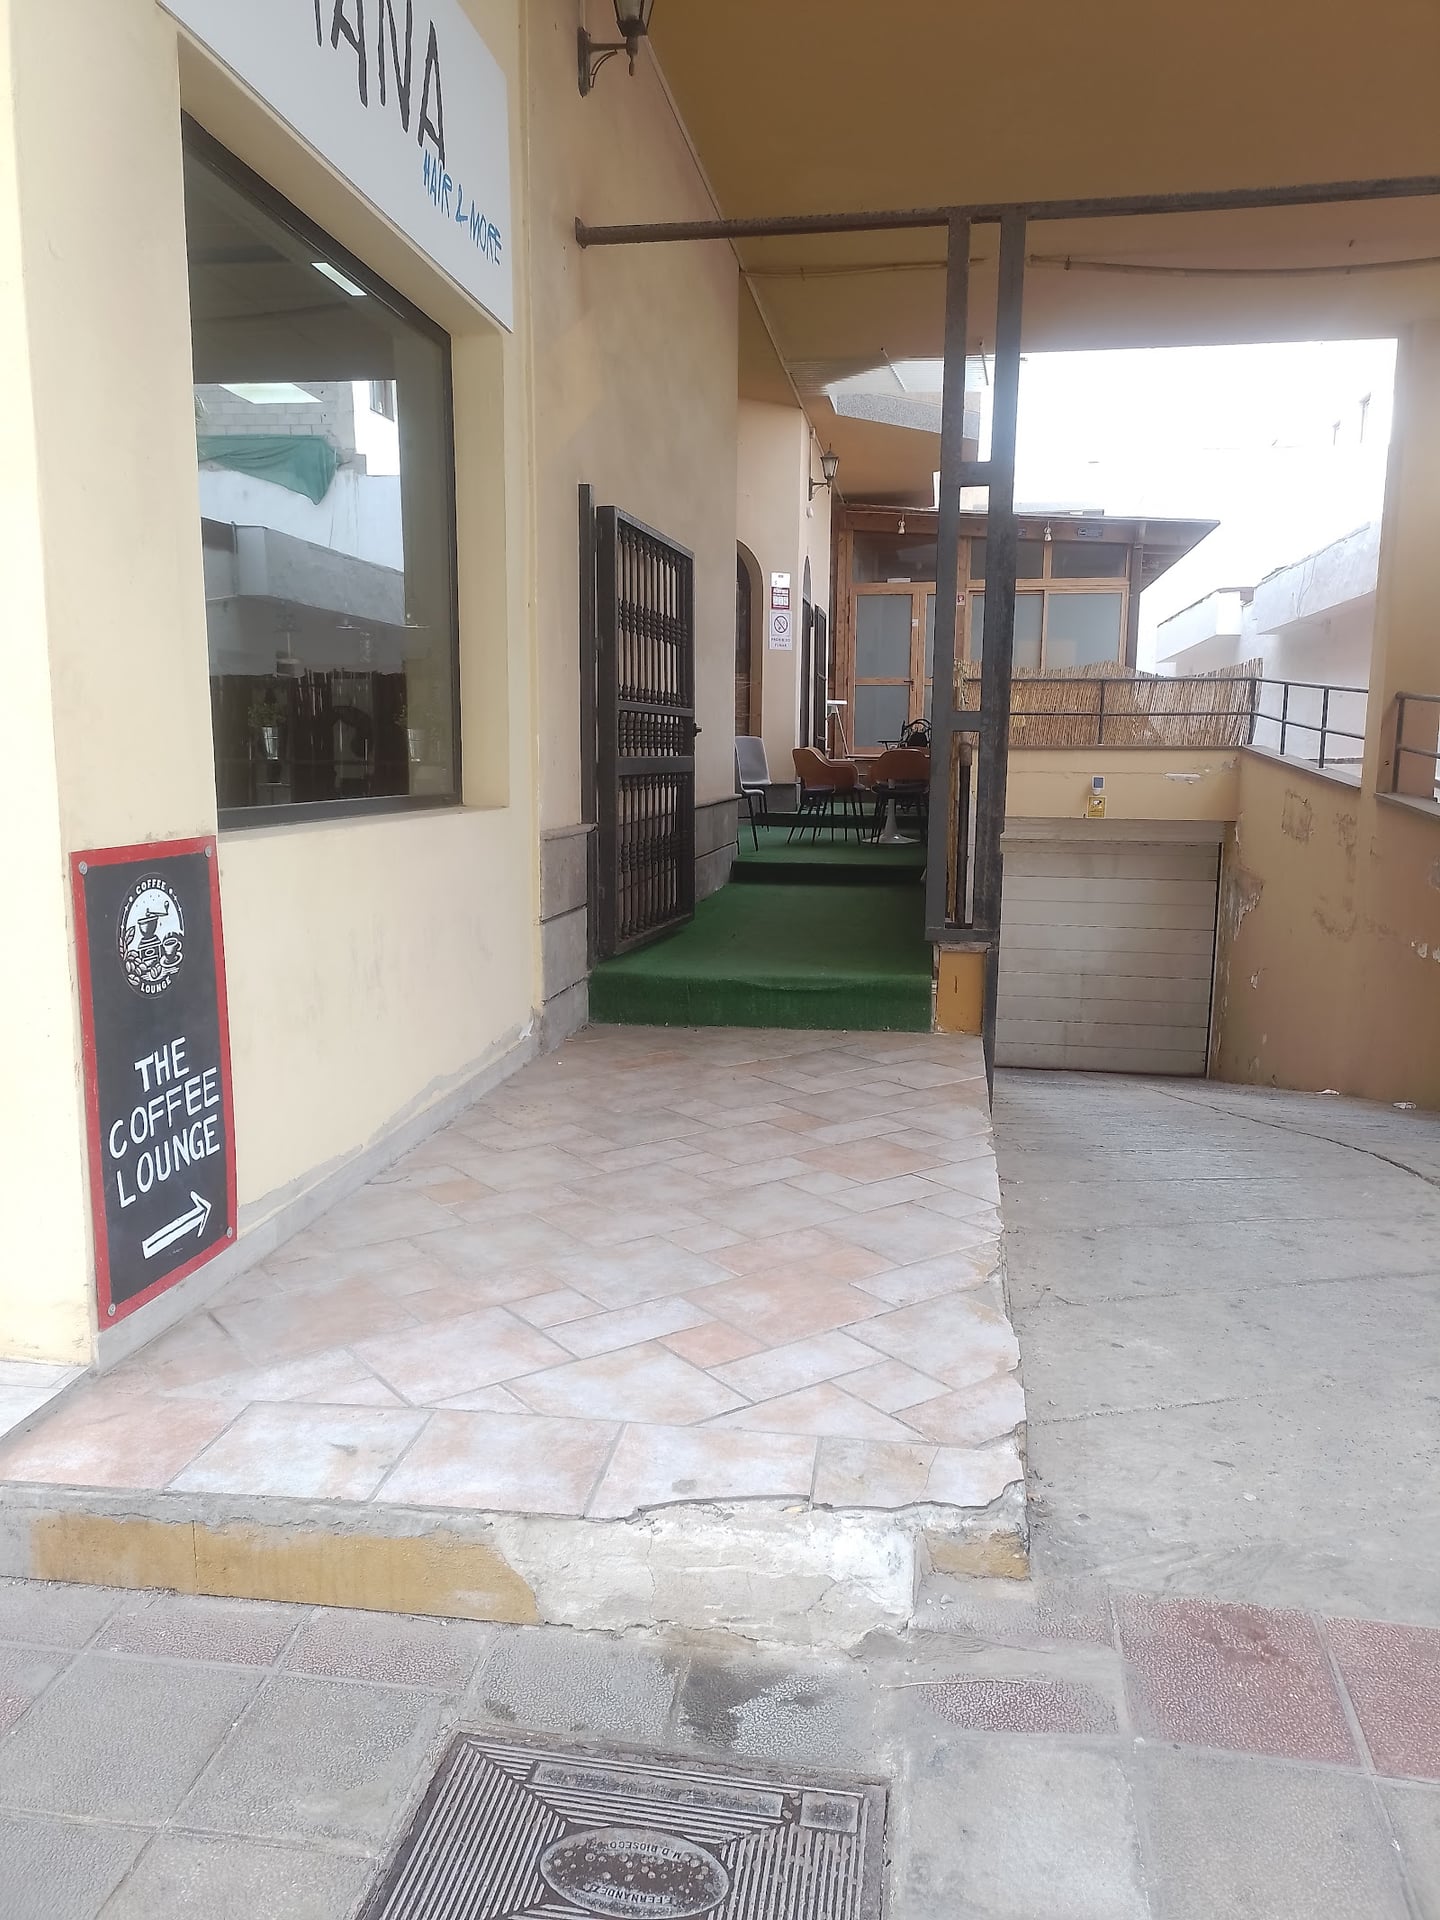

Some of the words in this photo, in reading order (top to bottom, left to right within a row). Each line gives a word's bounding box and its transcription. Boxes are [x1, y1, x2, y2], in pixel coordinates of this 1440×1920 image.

[423, 149, 453, 219] HAIR
[469, 199, 502, 266] MORE
[135, 878, 167, 895] COFFEE
[140, 975, 172, 995] LOUNGE
[134, 1036, 191, 1094] THE
[108, 1066, 221, 1160] COFFEE
[116, 1113, 221, 1209] LOUNGE
